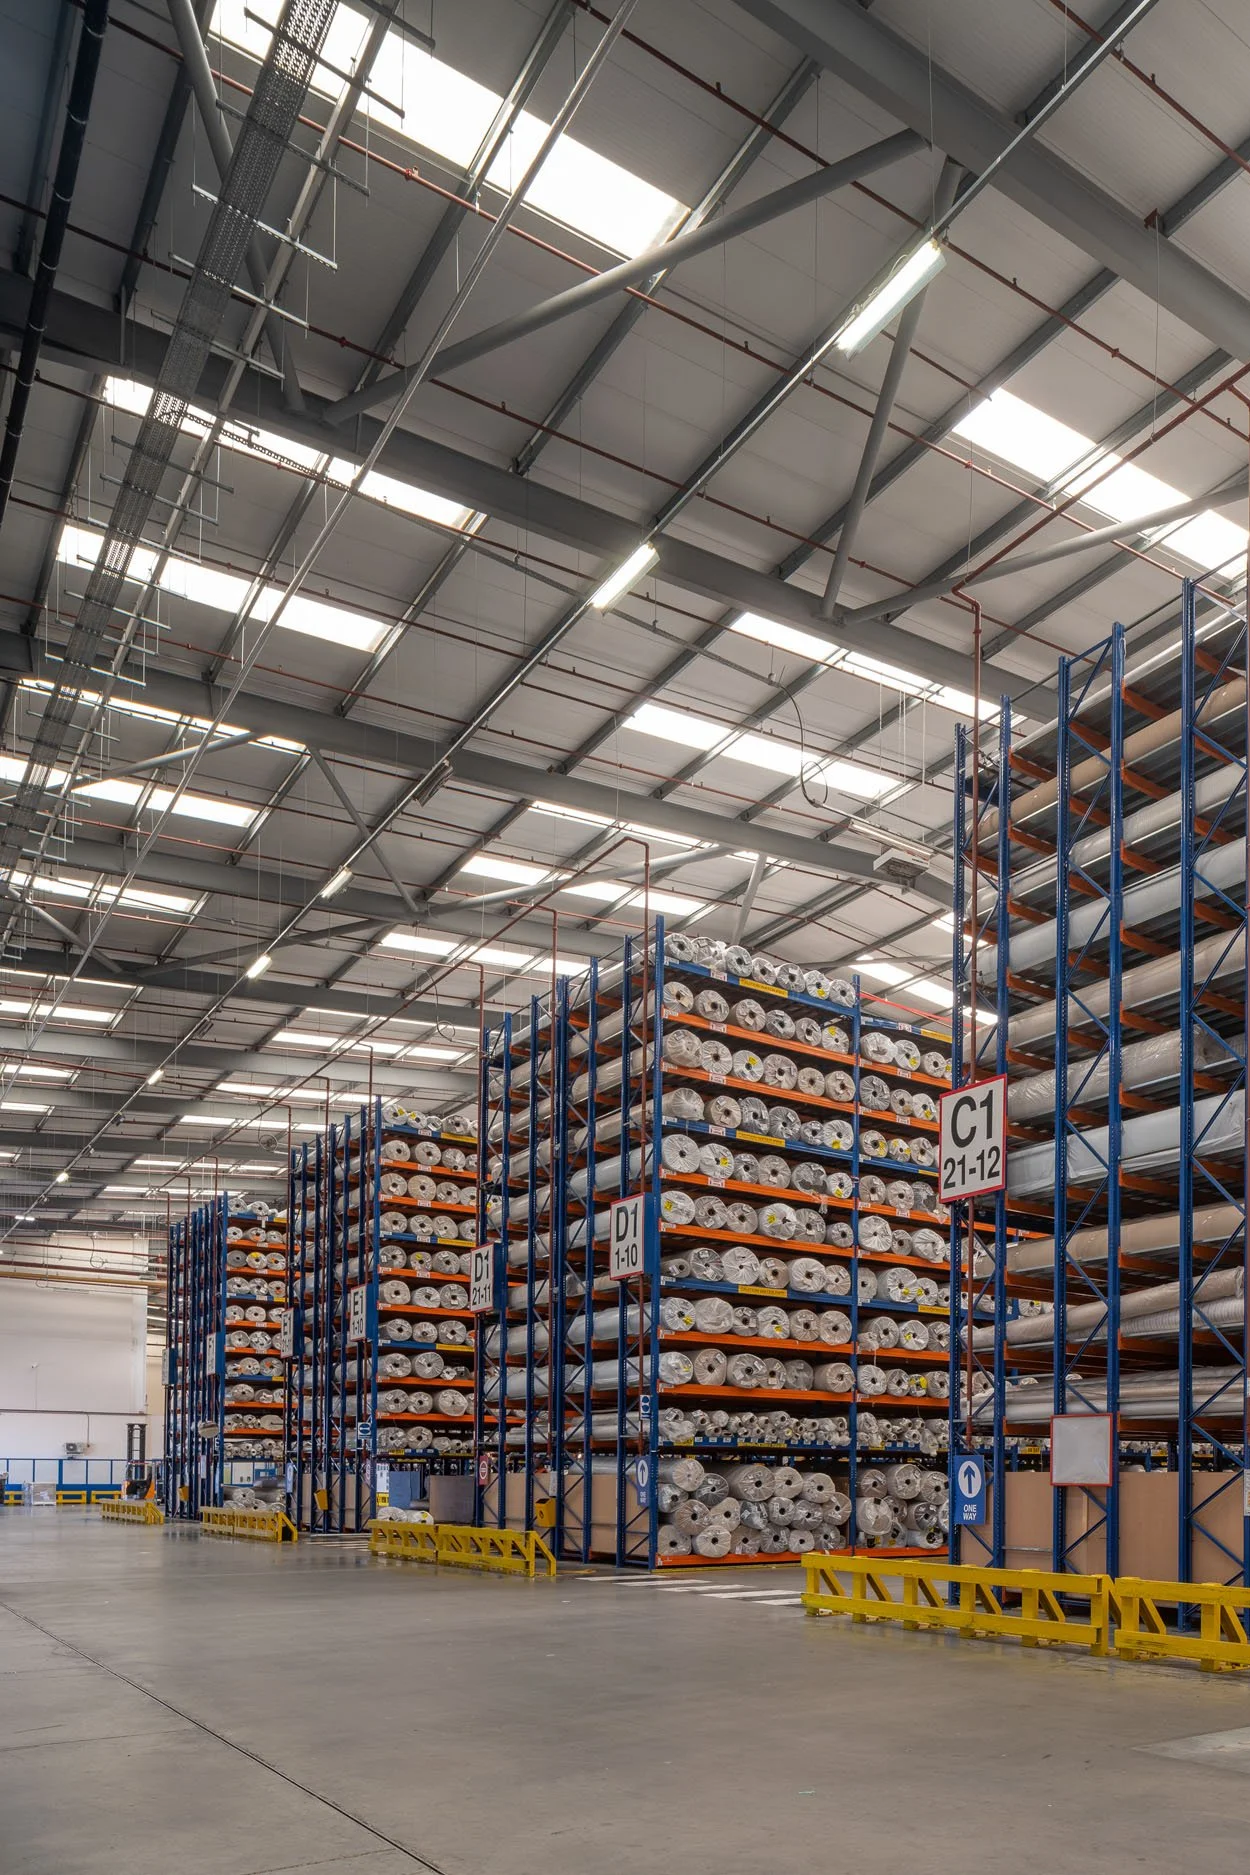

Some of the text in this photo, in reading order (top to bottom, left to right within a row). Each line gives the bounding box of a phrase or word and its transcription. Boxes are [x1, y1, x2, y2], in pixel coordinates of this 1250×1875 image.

[951, 1090, 994, 1149] C1
[943, 1145, 1000, 1190] 21-12
[616, 1202, 638, 1243] D1
[475, 1250, 489, 1282] D1
[615, 1243, 638, 1270] 1-10
[353, 1290, 363, 1316] E1
[472, 1283, 491, 1305] 21-11
[352, 1318, 363, 1335] 1-10
[963, 1504, 976, 1513] ONE
[963, 1512, 976, 1520] WAY
